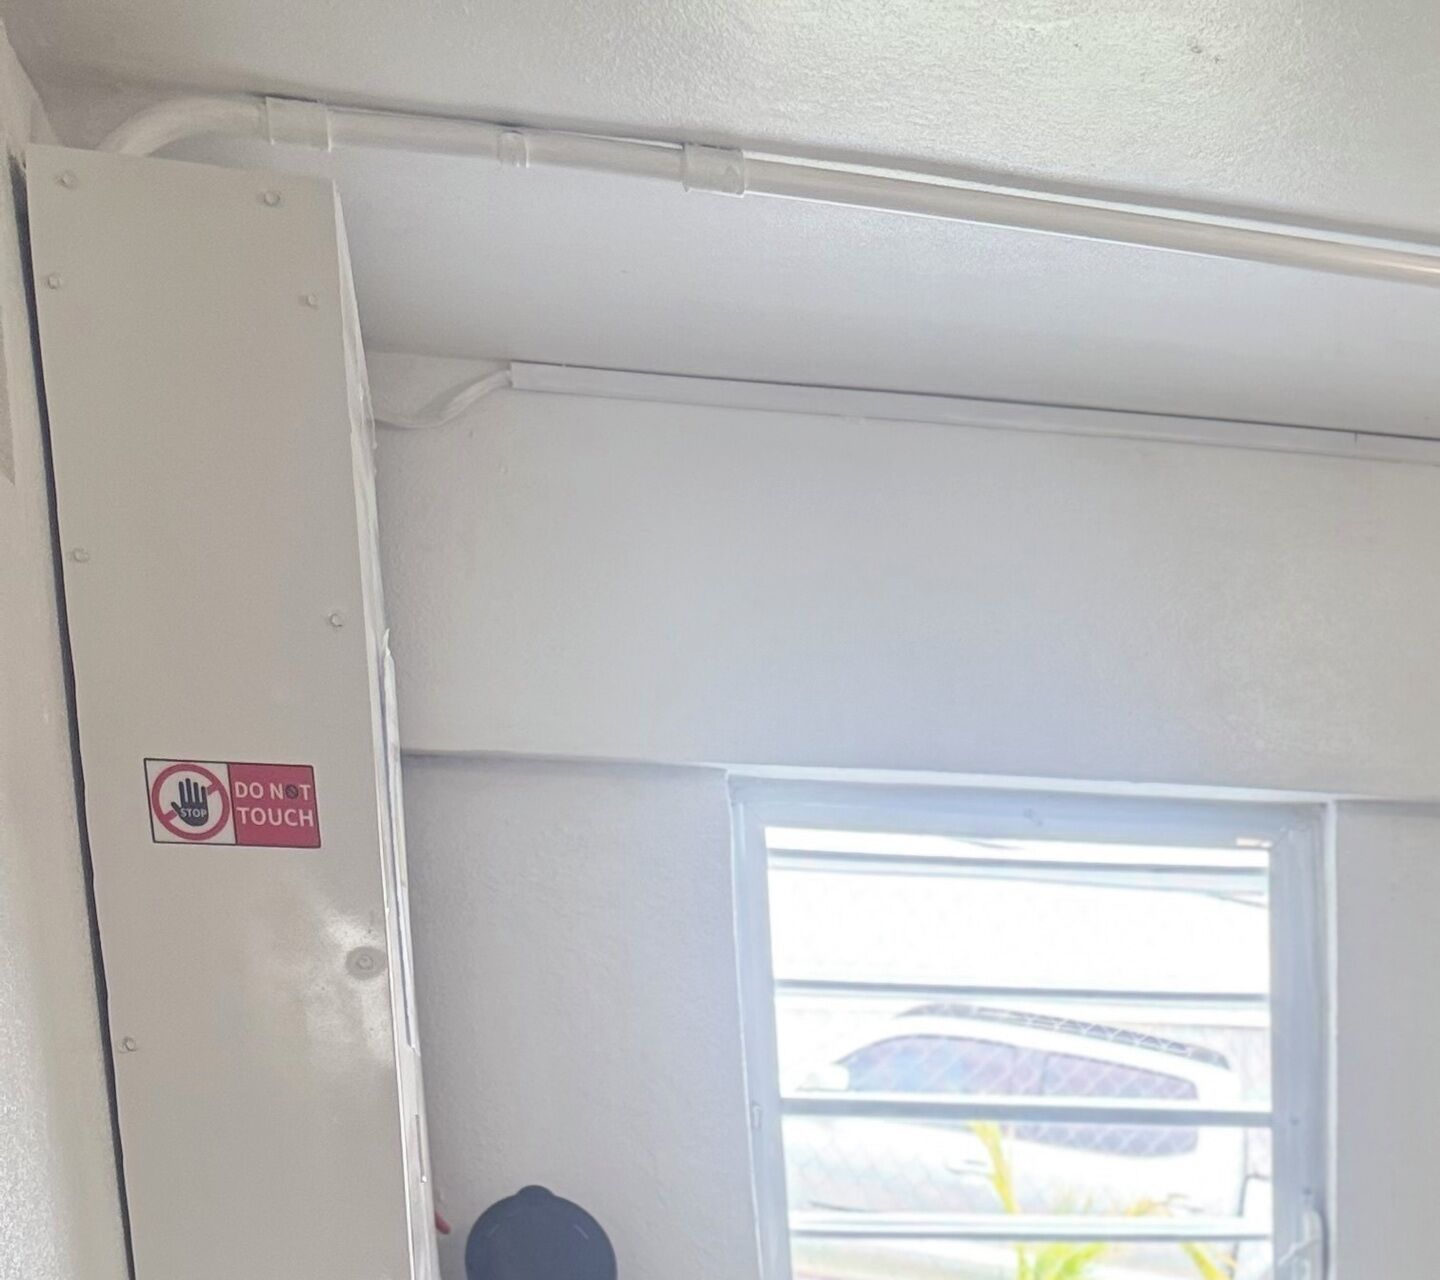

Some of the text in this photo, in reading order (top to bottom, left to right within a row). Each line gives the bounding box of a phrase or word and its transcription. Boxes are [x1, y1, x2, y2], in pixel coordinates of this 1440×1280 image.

[234, 781, 311, 800] DO NT
[180, 808, 207, 818] STOP
[236, 807, 314, 827] TOUCH
